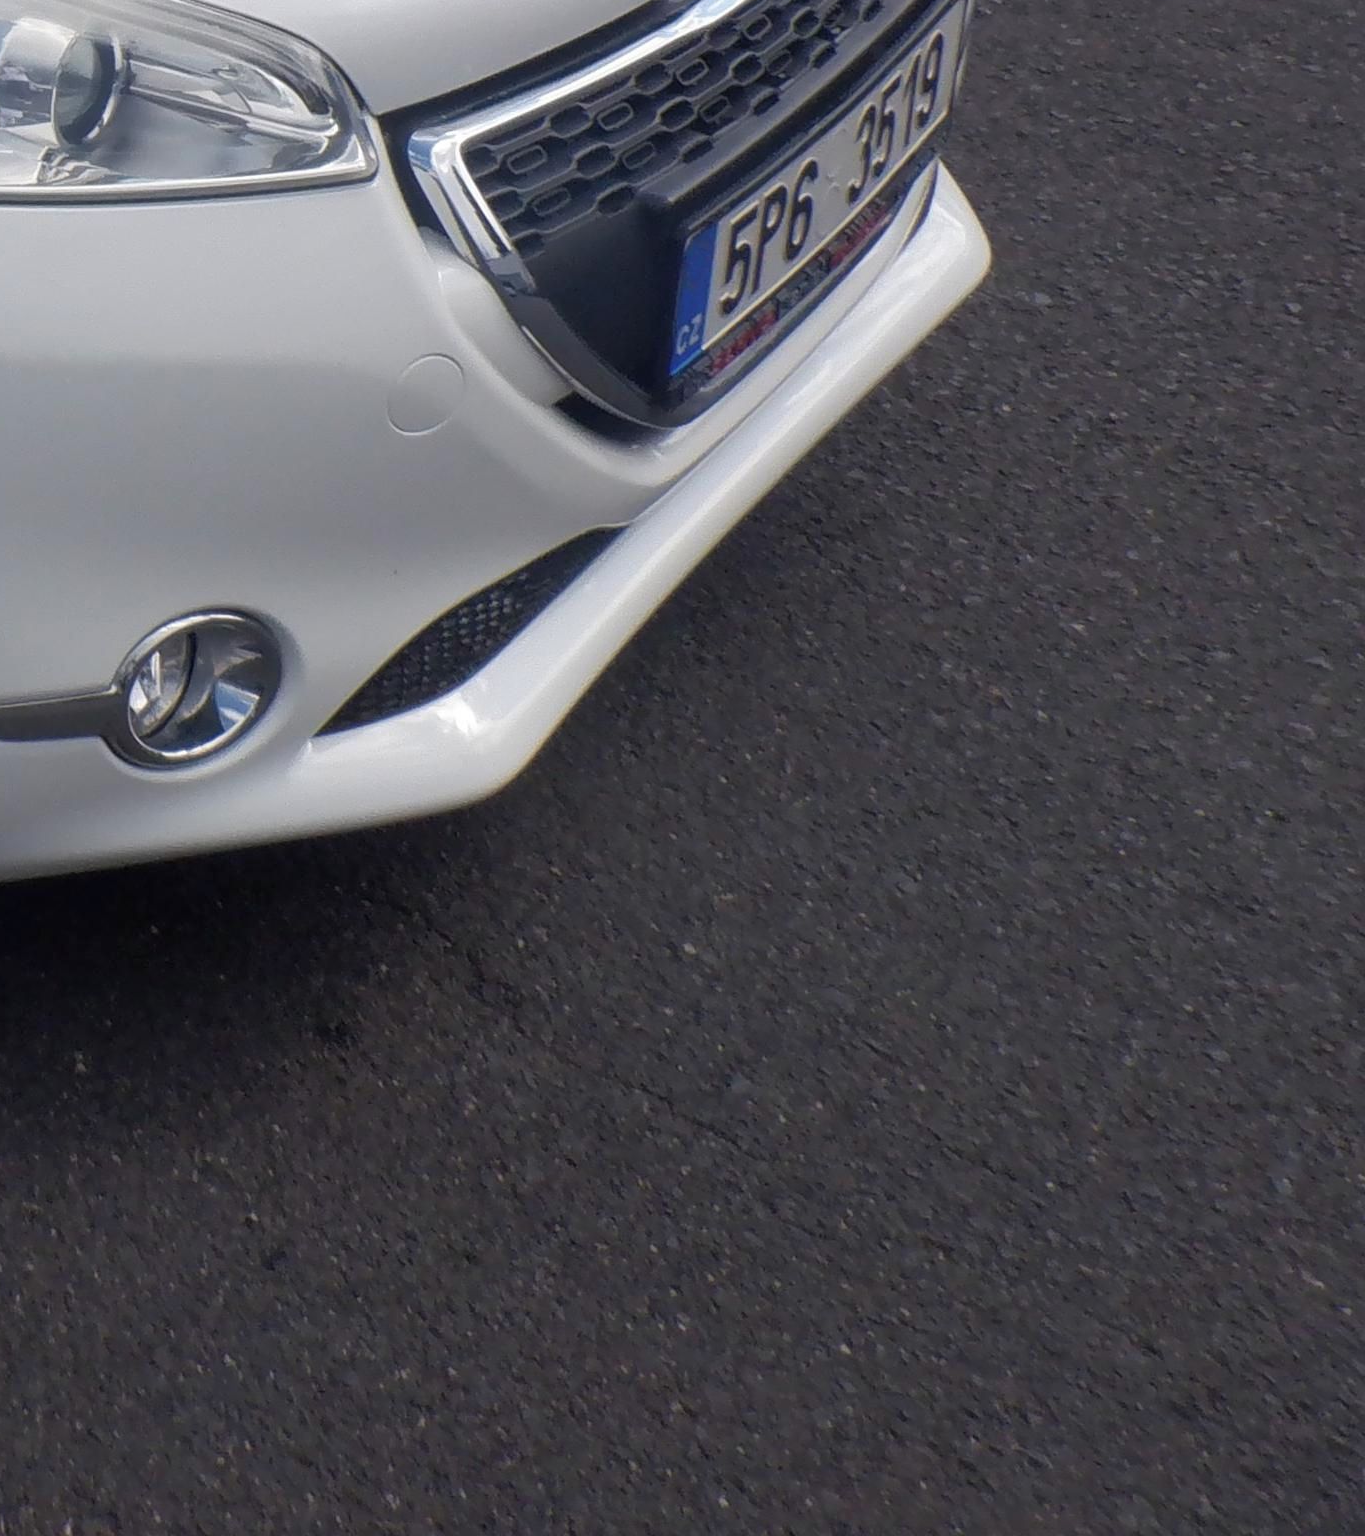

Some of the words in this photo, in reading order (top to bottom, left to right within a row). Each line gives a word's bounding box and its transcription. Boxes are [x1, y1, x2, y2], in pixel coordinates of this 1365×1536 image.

[676, 313, 703, 355] CZ
[720, 157, 819, 315] 5P6
[846, 29, 943, 206] 3519
